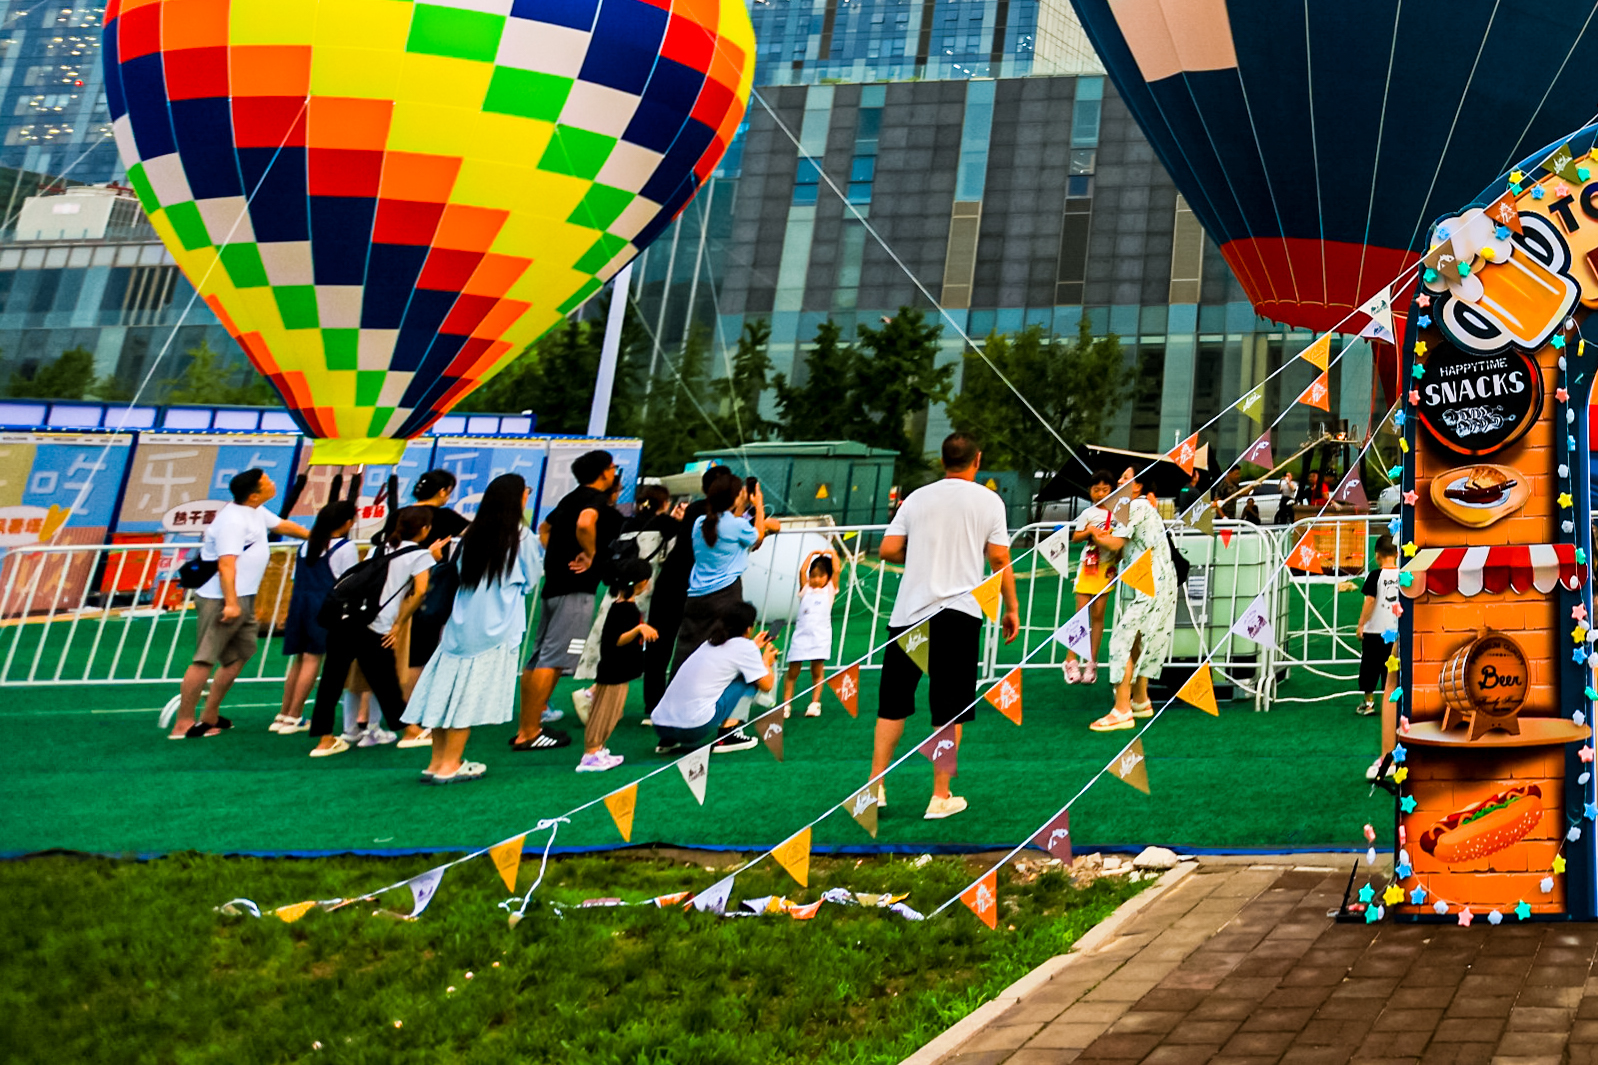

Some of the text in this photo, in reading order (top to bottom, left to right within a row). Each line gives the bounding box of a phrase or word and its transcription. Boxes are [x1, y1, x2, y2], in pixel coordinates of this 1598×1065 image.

[1440, 357, 1508, 378] HAPPYTIME
[1425, 371, 1525, 406] SNACKS
[1478, 665, 1522, 690] Beer
